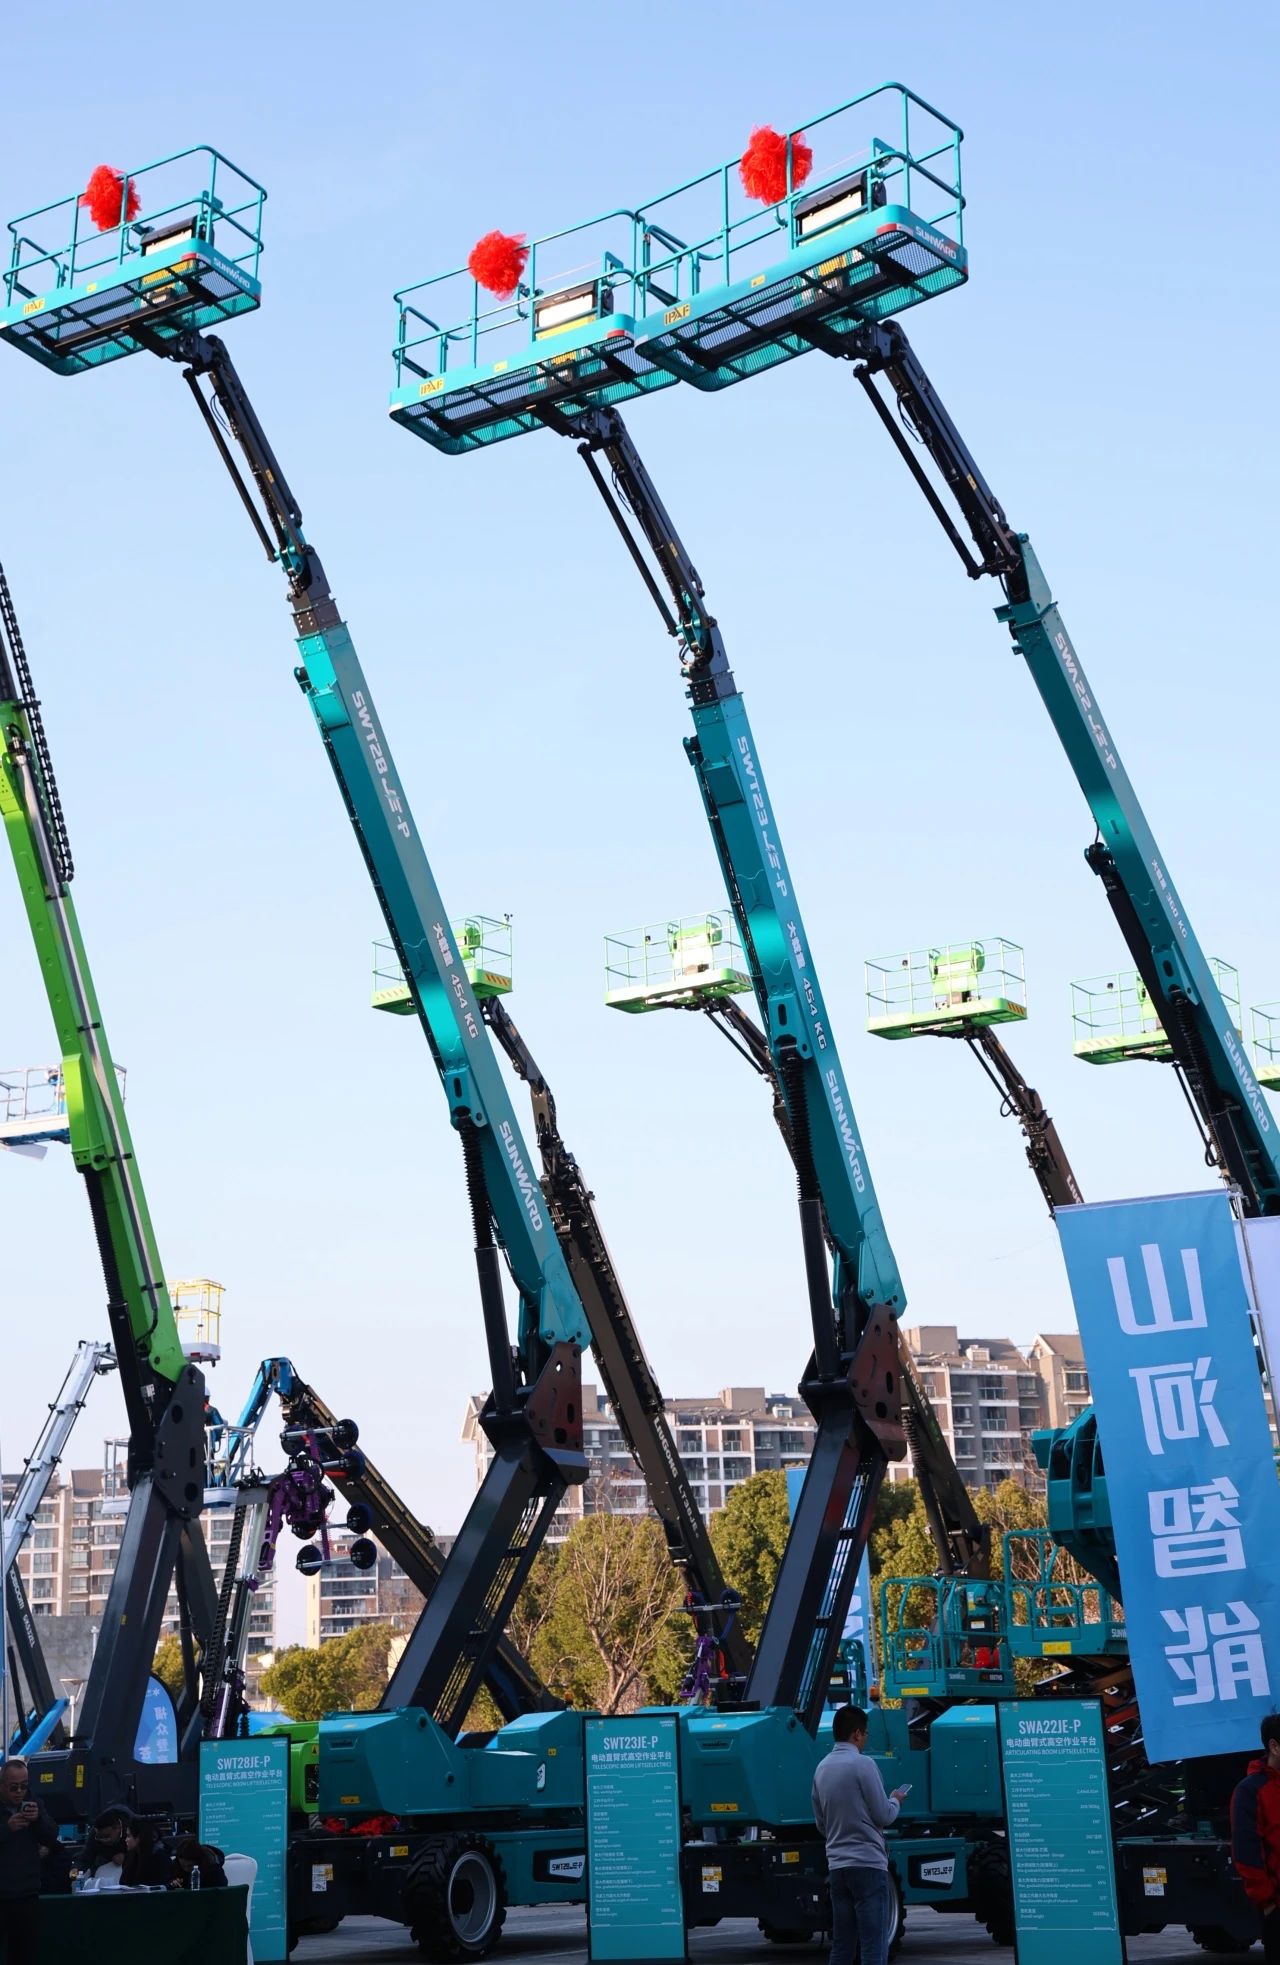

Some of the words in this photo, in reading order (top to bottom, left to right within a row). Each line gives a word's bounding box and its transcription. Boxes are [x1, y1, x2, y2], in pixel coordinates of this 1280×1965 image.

[914, 226, 957, 260] SUNWARD
[664, 305, 689, 325] IPAF
[420, 380, 443, 395] IPAF
[1178, 919, 1188, 939] KG
[450, 974, 468, 1010] 454
[463, 1012, 480, 1039] KG
[803, 978, 818, 1017] 454
[814, 1021, 828, 1050] KG
[1223, 1030, 1270, 1133] SUNWARD
[826, 1069, 866, 1193] SUNWARD
[499, 1120, 544, 1232] SUNWARD
[1018, 1719, 1081, 1735] SWA22JE-P
[603, 1735, 659, 1750] SWT23JE-P
[1006, 1736, 1097, 1748] 电动曲臂式高空作业平台
[217, 1755, 271, 1770] SWT28JE-P
[591, 1751, 672, 1763] 电动直臂式高空作业平台
[204, 1770, 283, 1782] 电动直臂式高空作业平台
